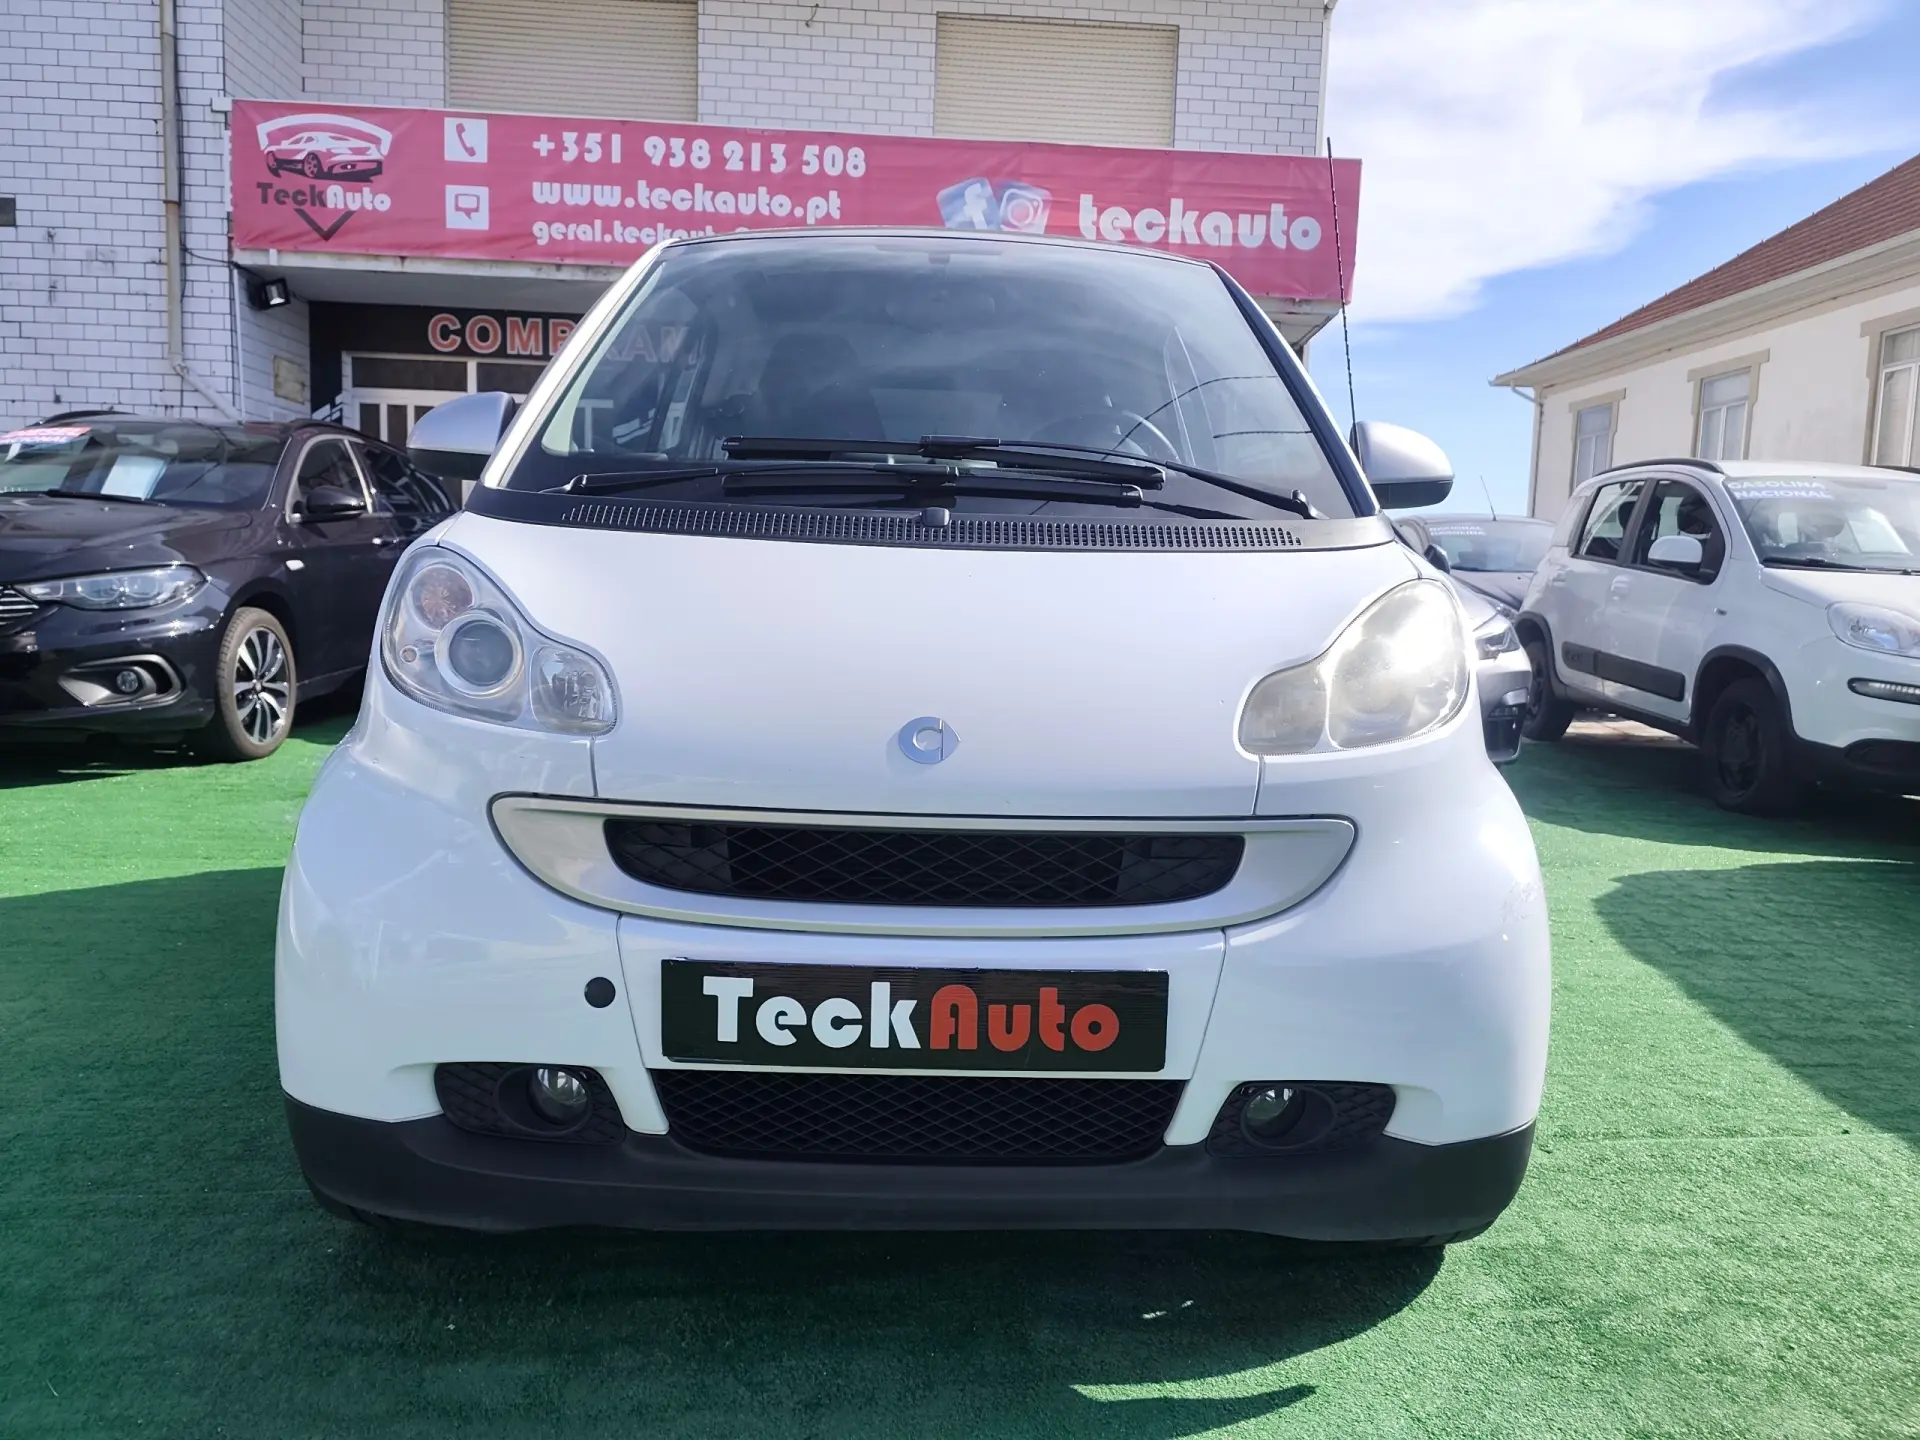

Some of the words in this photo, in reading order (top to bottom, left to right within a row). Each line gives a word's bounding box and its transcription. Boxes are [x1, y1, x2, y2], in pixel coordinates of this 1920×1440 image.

[532, 131, 622, 164] +351
[643, 135, 712, 169] 938
[722, 140, 787, 174] 213
[801, 144, 867, 178] 508
[256, 181, 392, 212] TeckAuto
[532, 179, 842, 225] www.teckauto.pt
[1078, 193, 1322, 251] teckauto
[1732, 490, 1835, 501] NACIONAL
[702, 975, 1120, 1052] TeckAuto
